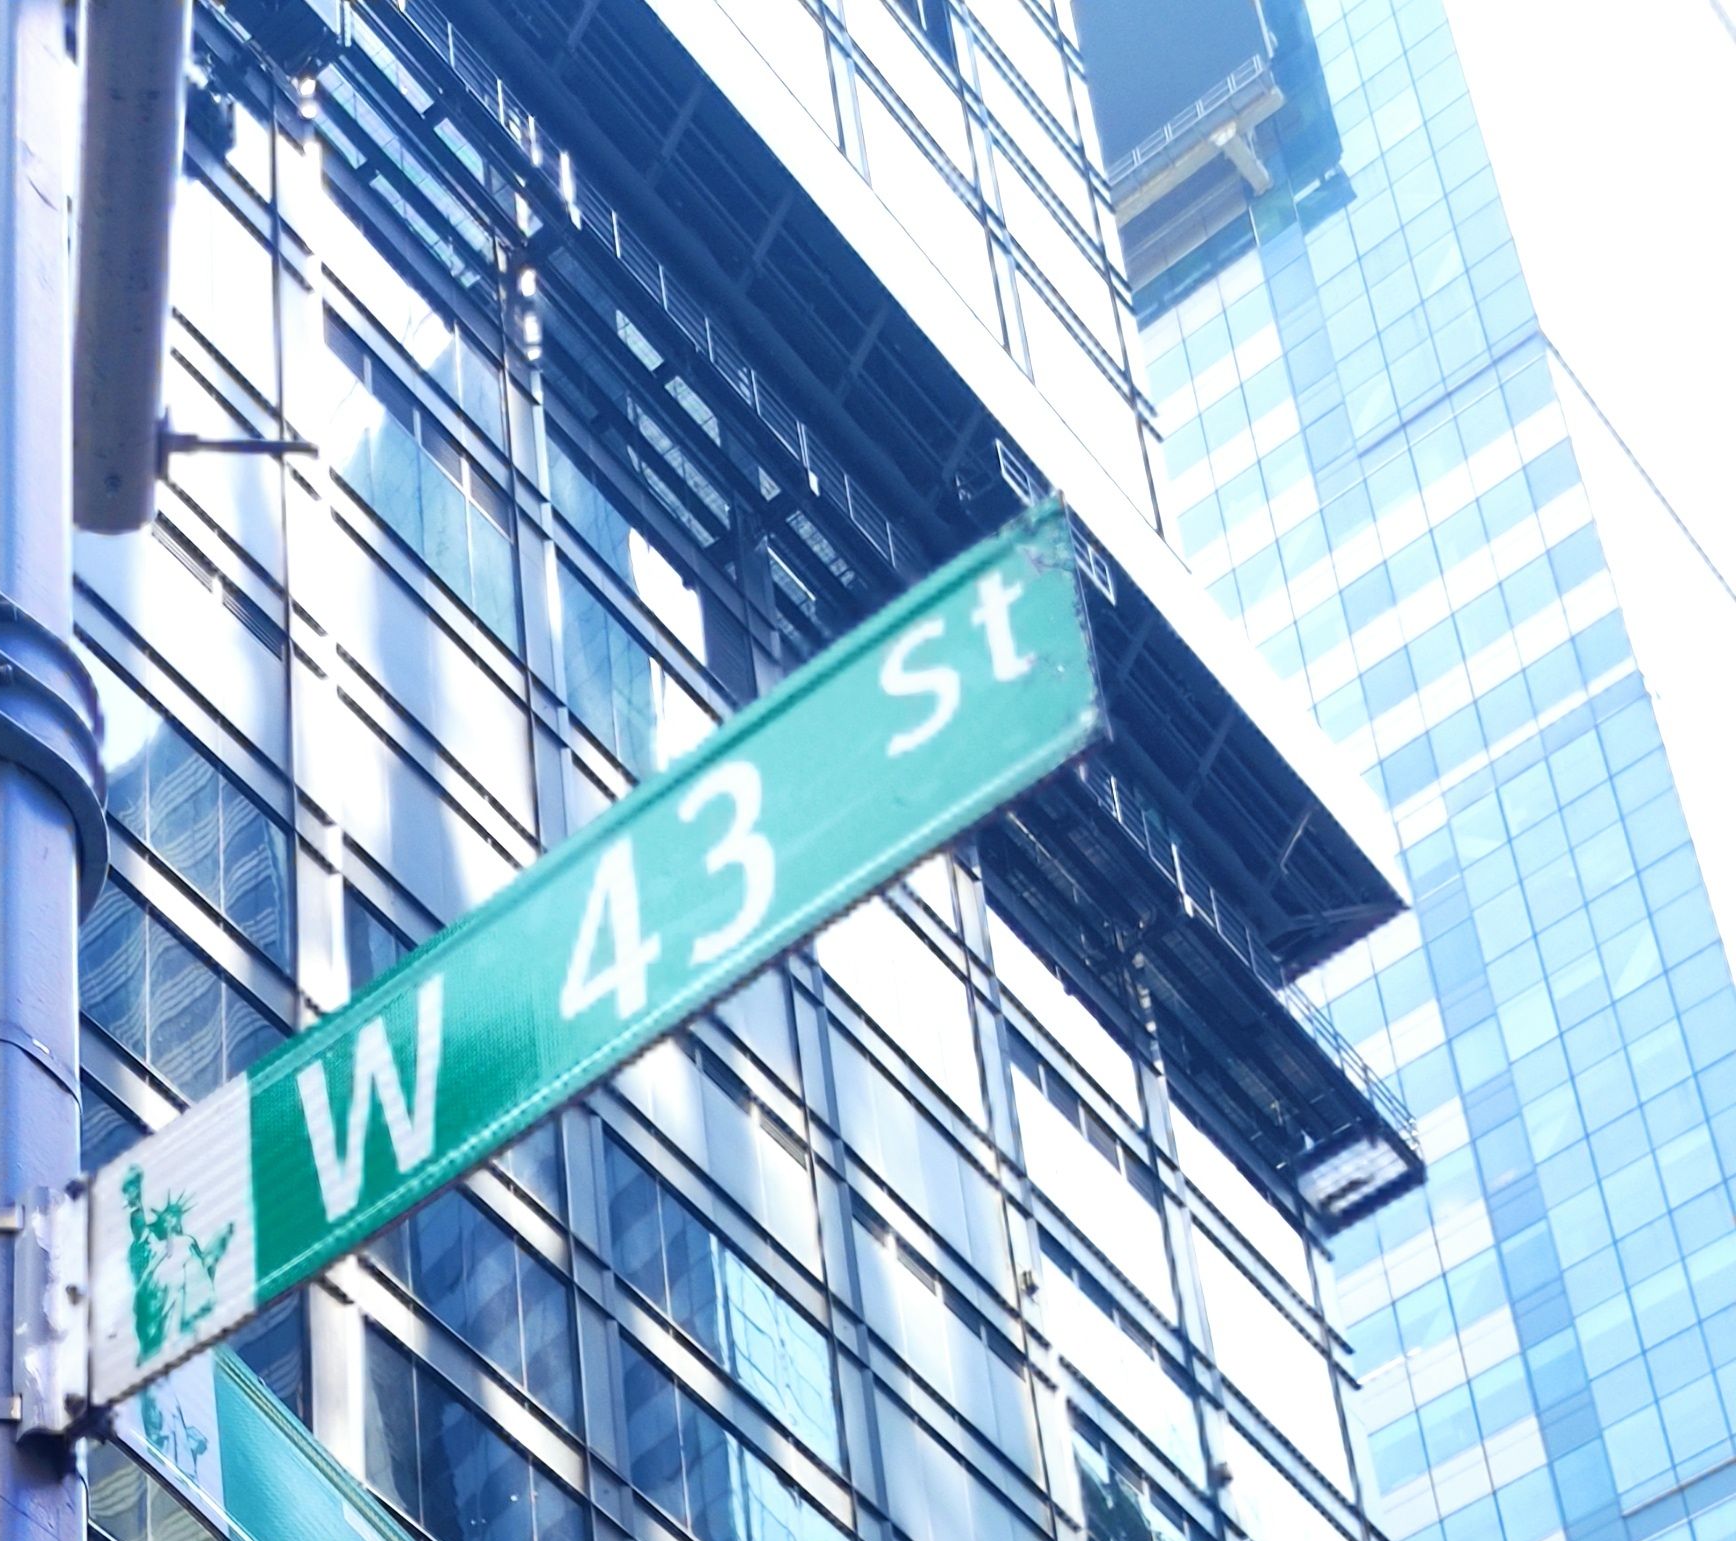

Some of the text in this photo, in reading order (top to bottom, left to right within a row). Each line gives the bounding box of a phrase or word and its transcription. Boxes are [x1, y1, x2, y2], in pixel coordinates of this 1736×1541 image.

[299, 571, 1043, 1225] W 43 St
